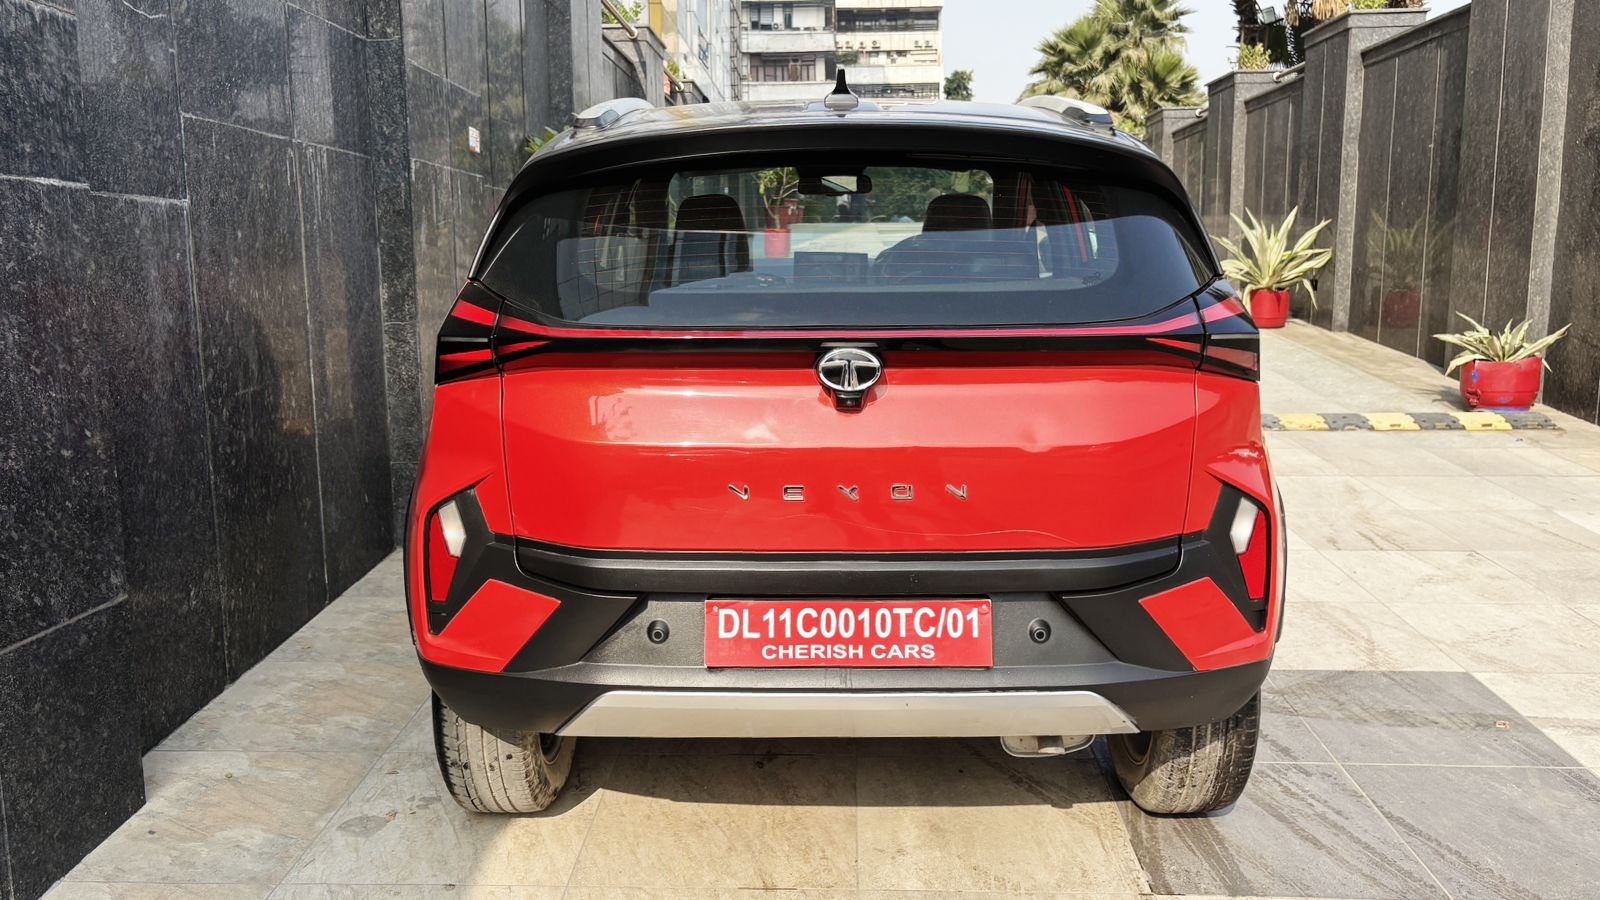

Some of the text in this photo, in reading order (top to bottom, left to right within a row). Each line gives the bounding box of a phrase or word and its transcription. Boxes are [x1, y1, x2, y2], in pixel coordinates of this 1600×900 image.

[728, 484, 967, 501] NEXON
[718, 607, 979, 639] DL11C0010TC/01
[761, 644, 936, 660] CHERISH CARS
